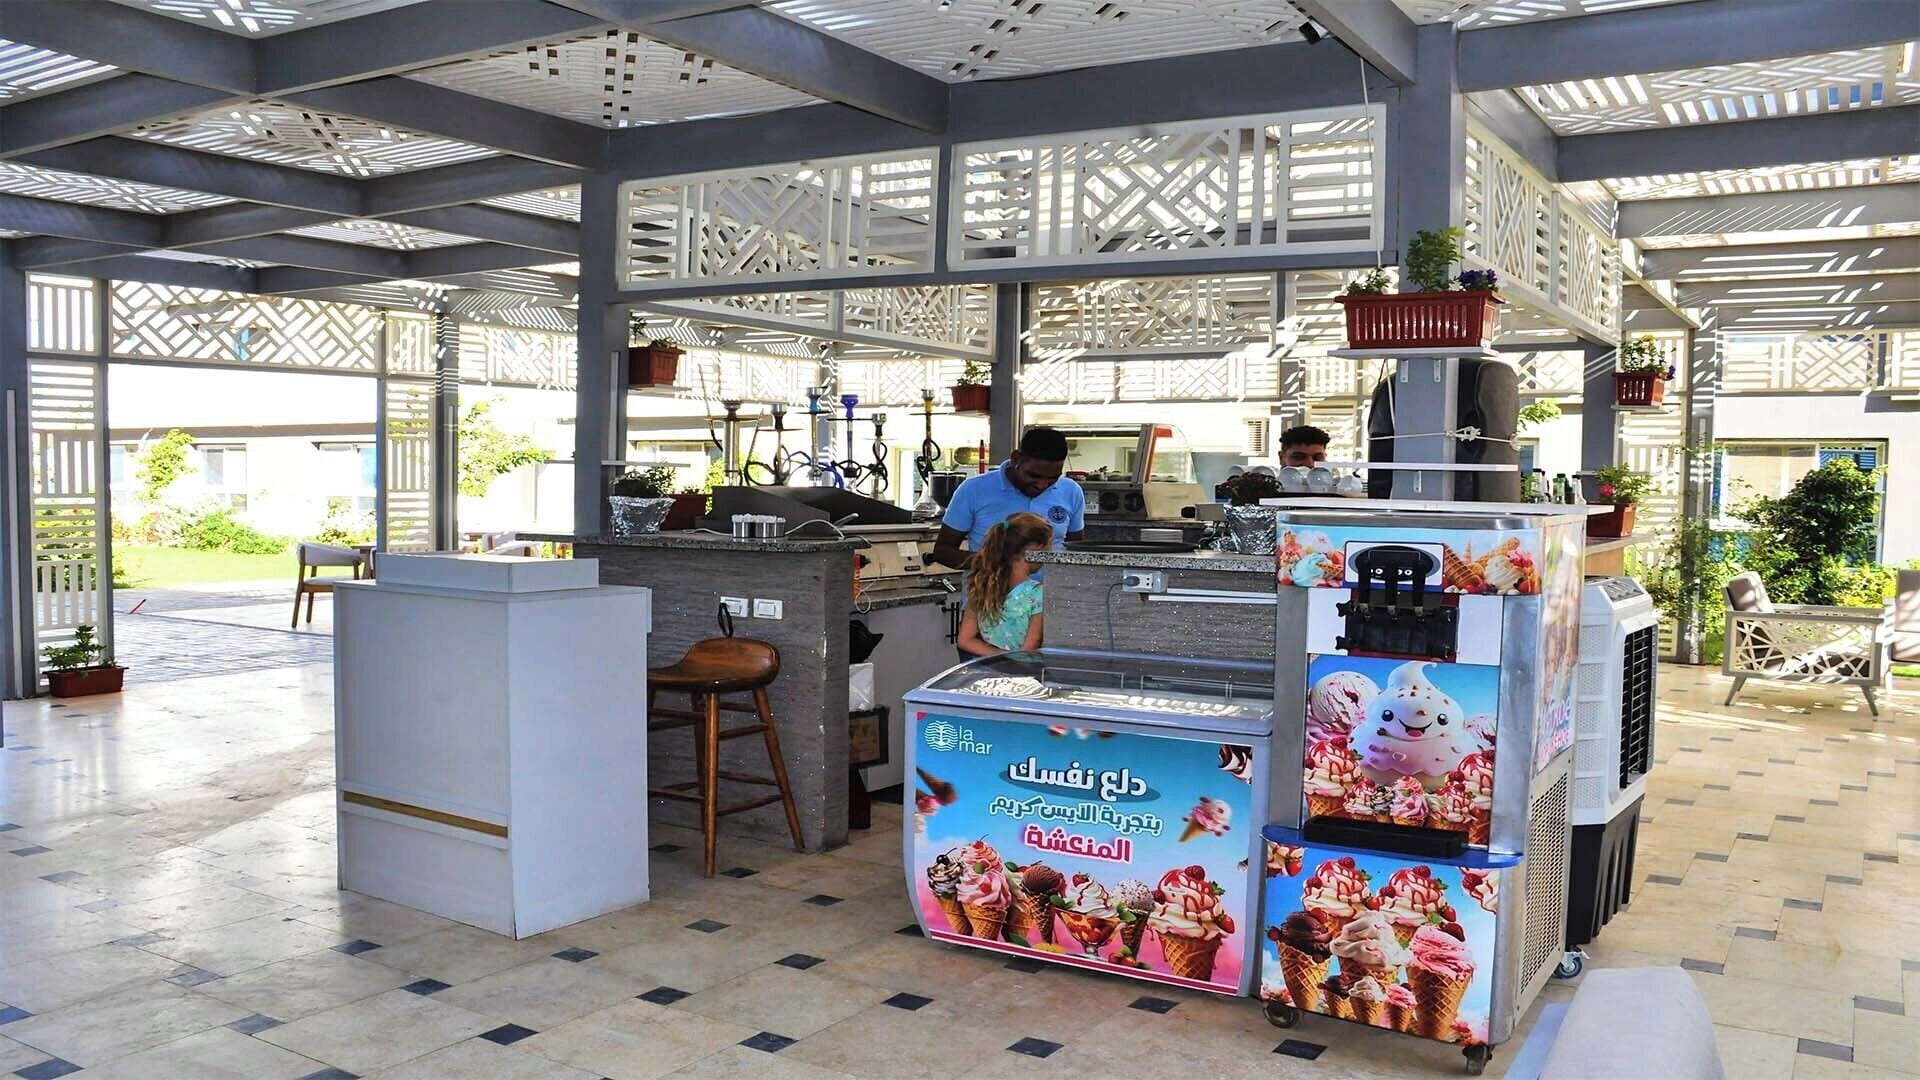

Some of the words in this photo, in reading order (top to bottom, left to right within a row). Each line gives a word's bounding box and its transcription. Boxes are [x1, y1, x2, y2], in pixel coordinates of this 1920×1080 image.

[958, 740, 993, 755] mar
[959, 725, 974, 742] la
[1008, 755, 1096, 792] نفسك
[1100, 766, 1148, 802] دلع
[990, 795, 1045, 819] كريم
[1101, 805, 1164, 836] بتجربة
[1026, 825, 1132, 862] المنعشة
